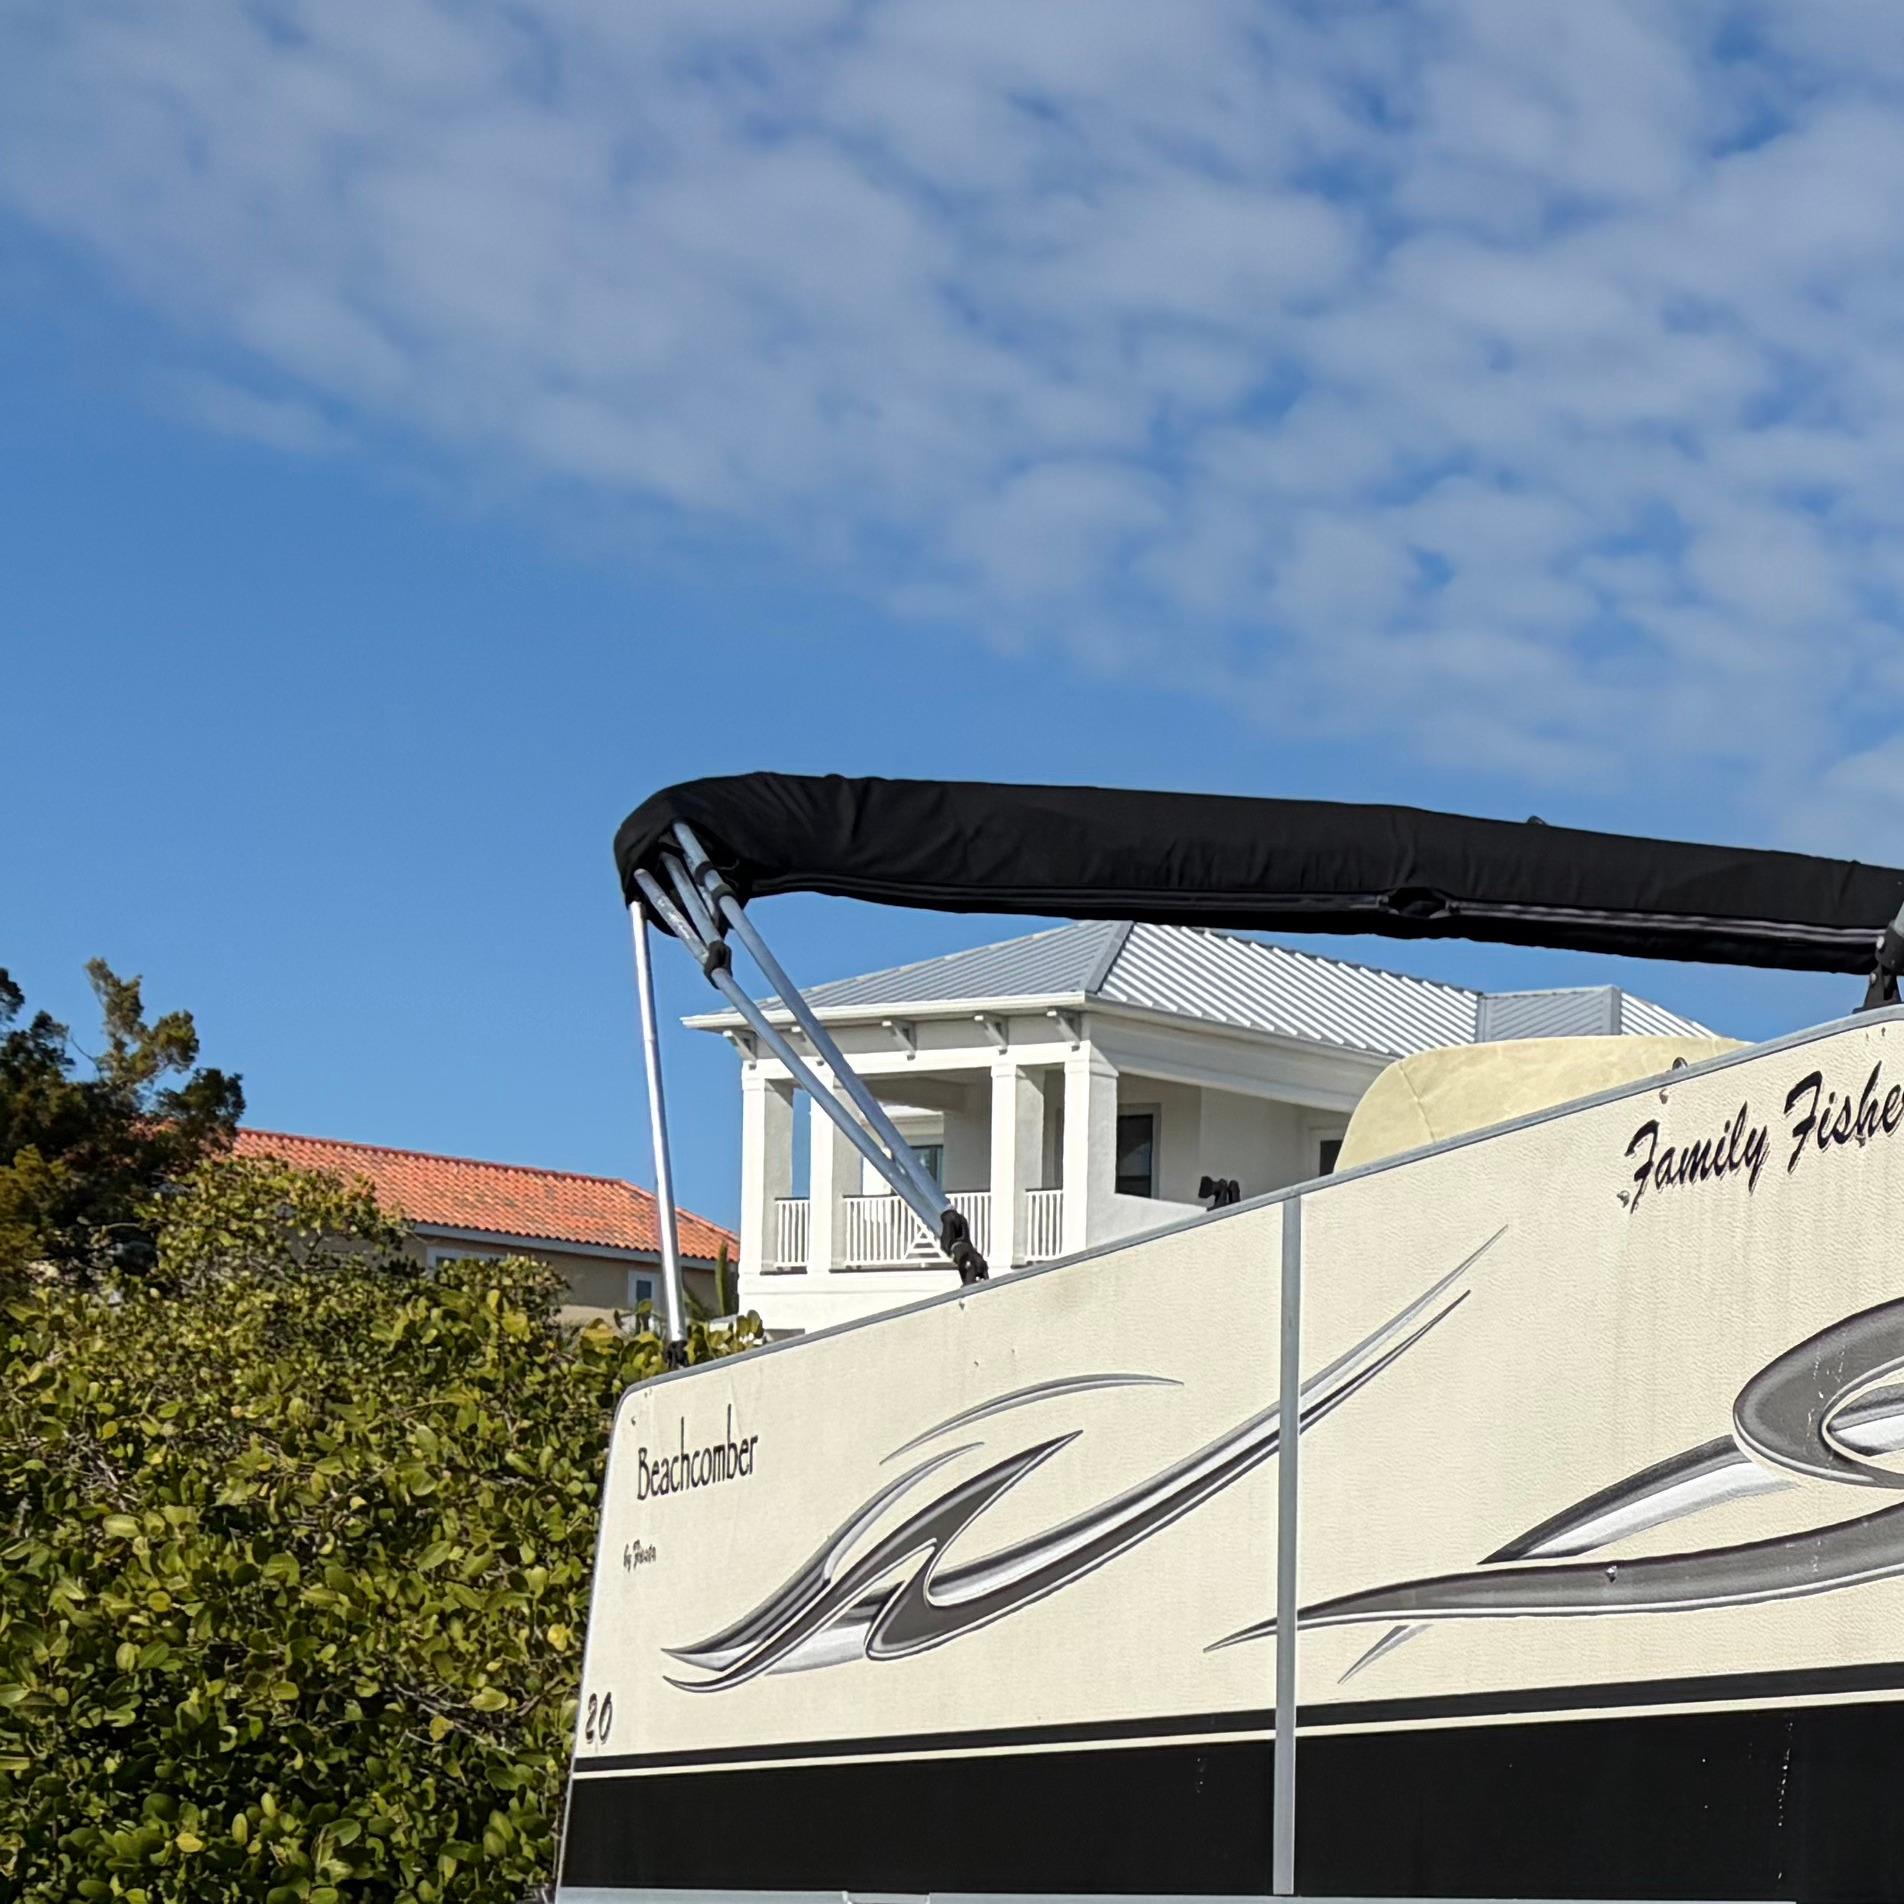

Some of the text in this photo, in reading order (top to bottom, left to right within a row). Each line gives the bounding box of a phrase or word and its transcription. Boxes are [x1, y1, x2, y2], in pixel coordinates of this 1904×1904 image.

[1624, 1100, 1770, 1214] Family
[637, 1403, 758, 1500] Beachcomber
[585, 1692, 612, 1744] 20
